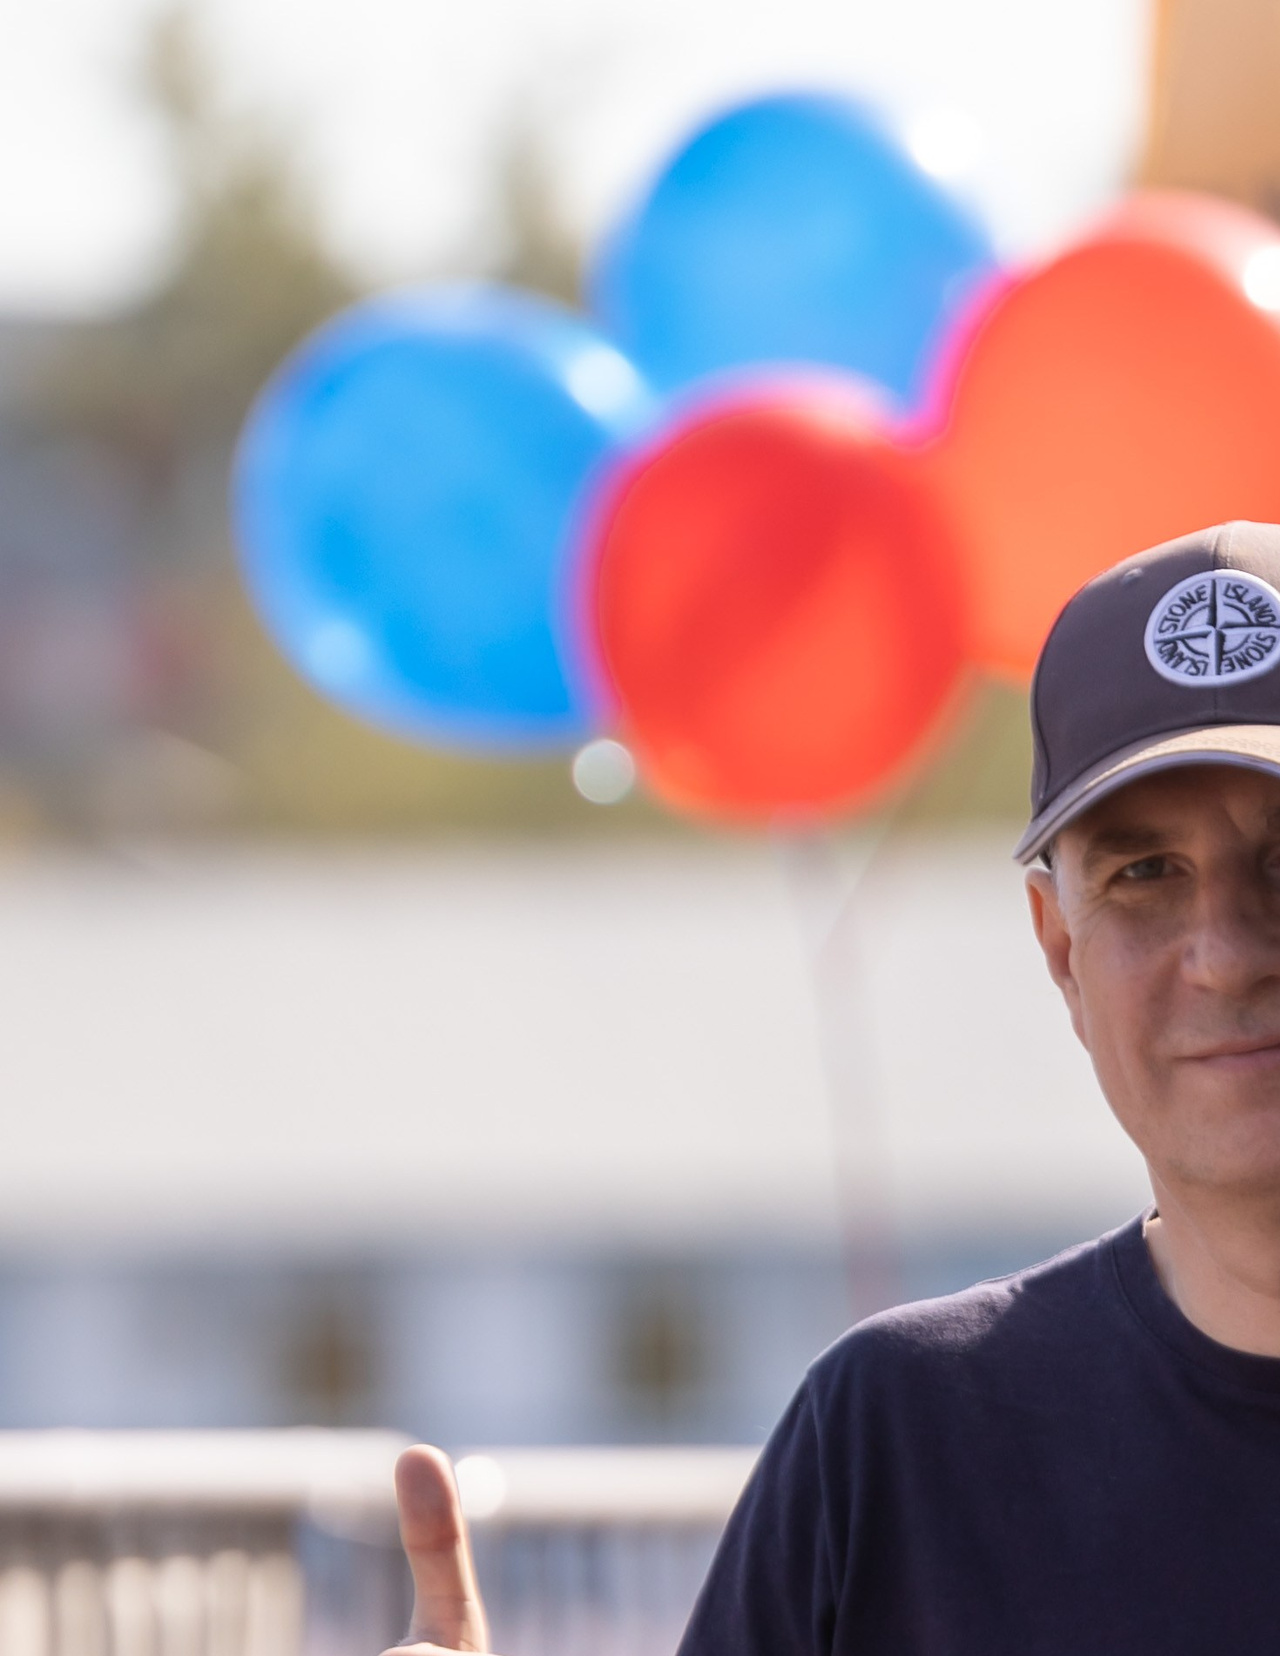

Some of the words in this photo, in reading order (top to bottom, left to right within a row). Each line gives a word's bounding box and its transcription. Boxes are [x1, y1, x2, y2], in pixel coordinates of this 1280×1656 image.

[1158, 584, 1207, 634] STONE
[1223, 582, 1277, 627] ISLAND
[1158, 641, 1208, 676] ISLAND
[1224, 632, 1277, 673] STONE
